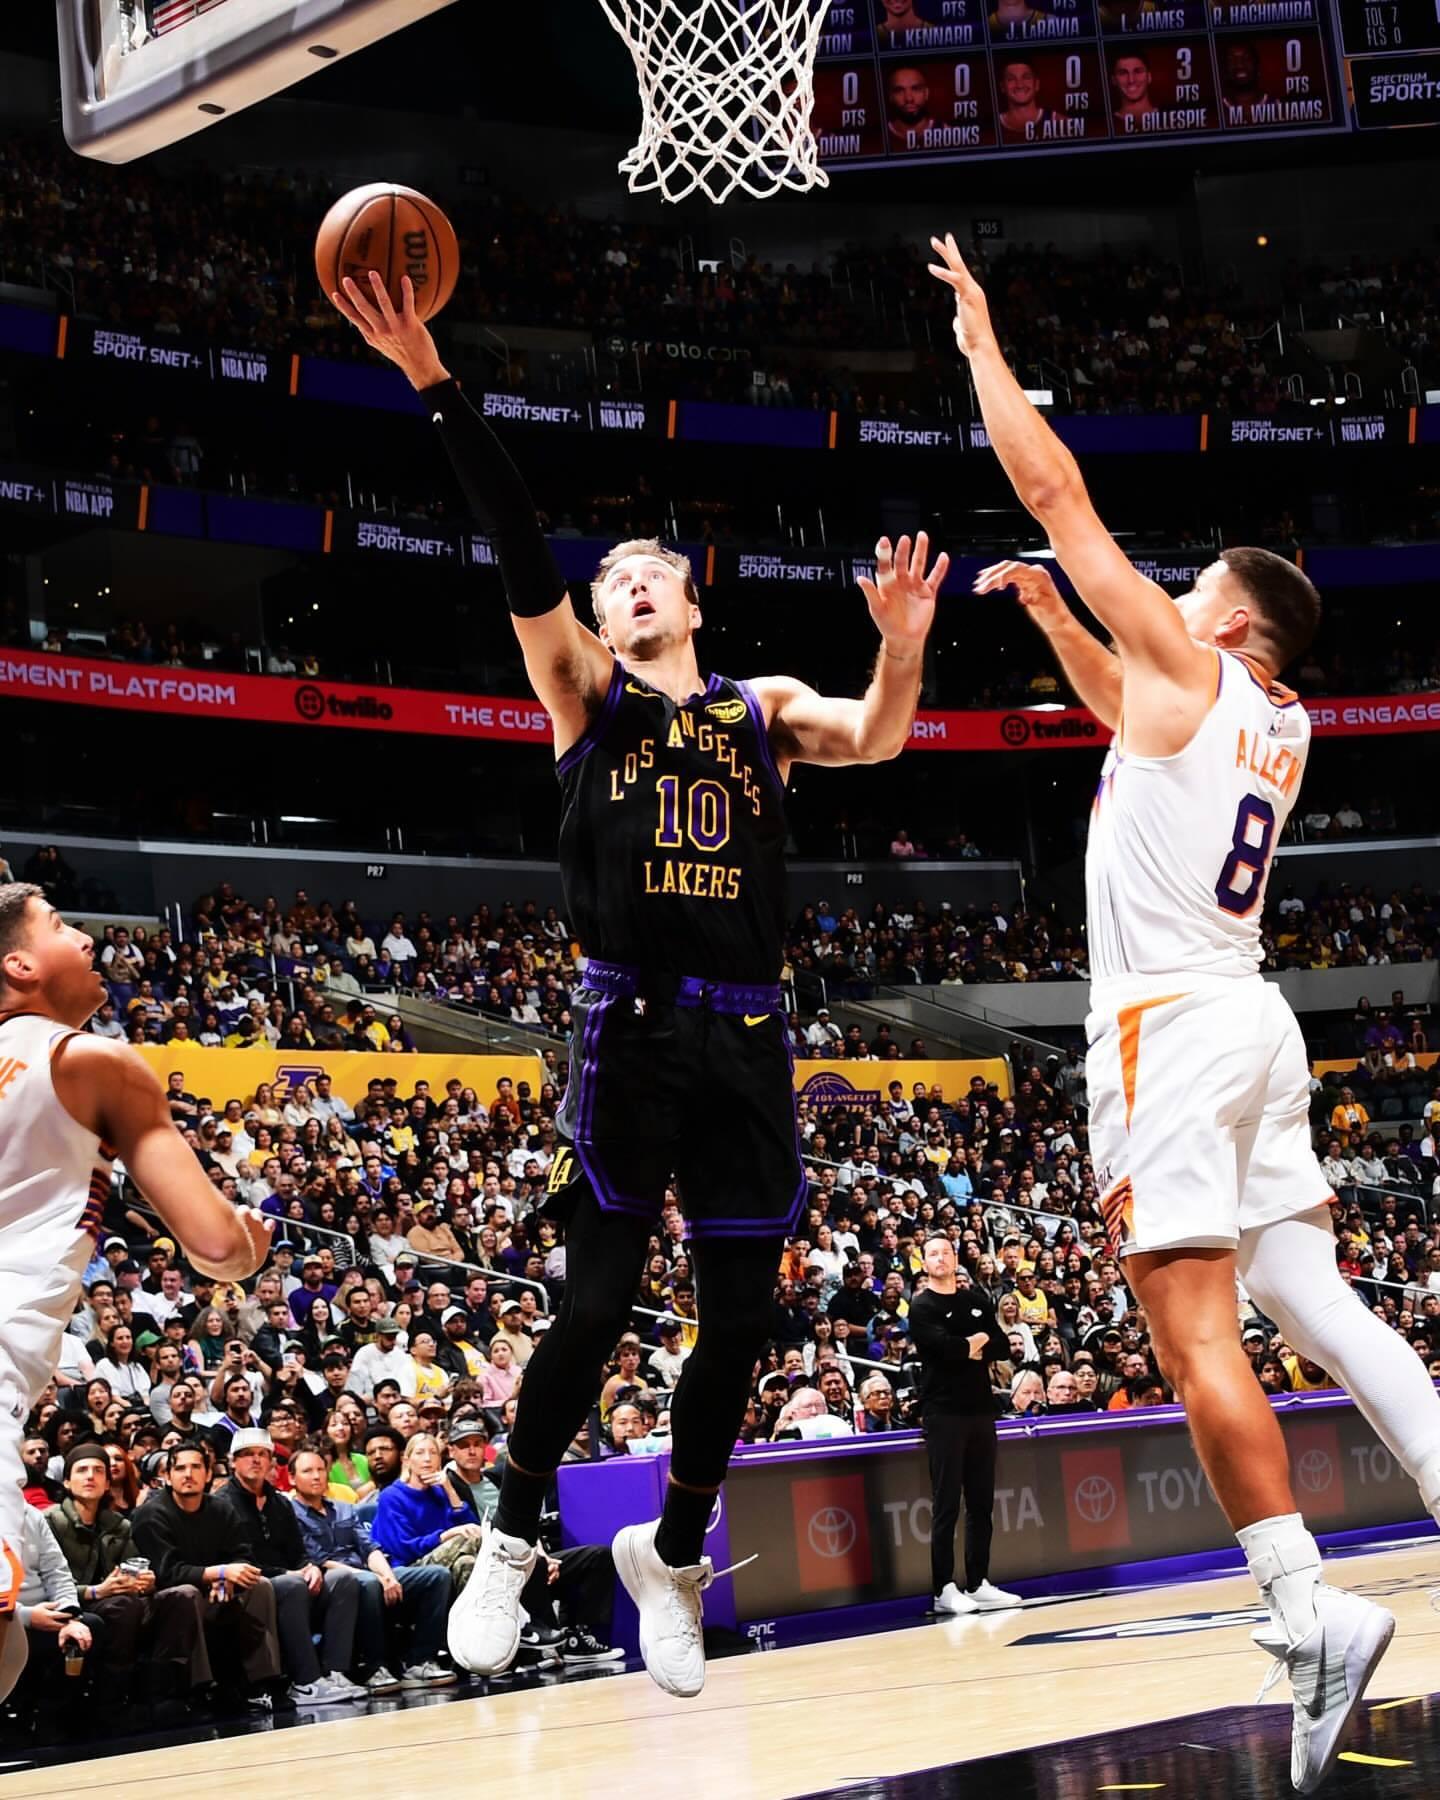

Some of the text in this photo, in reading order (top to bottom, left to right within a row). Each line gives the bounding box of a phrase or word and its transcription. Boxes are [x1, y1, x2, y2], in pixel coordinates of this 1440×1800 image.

[830, 8, 855, 26] PTS
[1121, 9, 1185, 33] L. JAMES
[1229, 0, 1313, 24] HACHIMURA
[1364, 7, 1385, 26] TOL
[905, 25, 973, 48] KENNARD
[1006, 21, 1019, 40] J.
[1366, 27, 1388, 47] FLS
[1176, 47, 1192, 80] 3
[1285, 39, 1301, 72] 0
[954, 63, 970, 97] 0
[1065, 55, 1081, 89] 0
[1369, 72, 1428, 85] SPECTRUM
[842, 72, 858, 105] 0
[1176, 84, 1199, 102] PTS
[1285, 76, 1310, 95] PTS
[953, 100, 977, 119] PTS
[1065, 92, 1088, 110] PTS
[1229, 99, 1323, 126] M. WILLIAMS
[842, 108, 866, 127] PTS
[1043, 117, 1085, 139] ALLEN
[1141, 108, 1207, 131] GILLESPIE
[924, 125, 980, 147] BROOKS
[221, 357, 268, 383] NBA APP
[600, 408, 646, 430] NBA APP
[1341, 421, 1385, 441] NBA APP
[64, 489, 114, 518] NBA APP
[90, 672, 236, 705] PLATFORM
[326, 693, 393, 720] twilio
[446, 704, 493, 726] THE
[1032, 718, 1098, 740] twilio
[609, 710, 761, 817] LOS ANGELES
[1235, 728, 1302, 798] ALLEN
[655, 774, 731, 853] 10
[1214, 792, 1276, 918] 8
[643, 859, 742, 900] LAKERS
